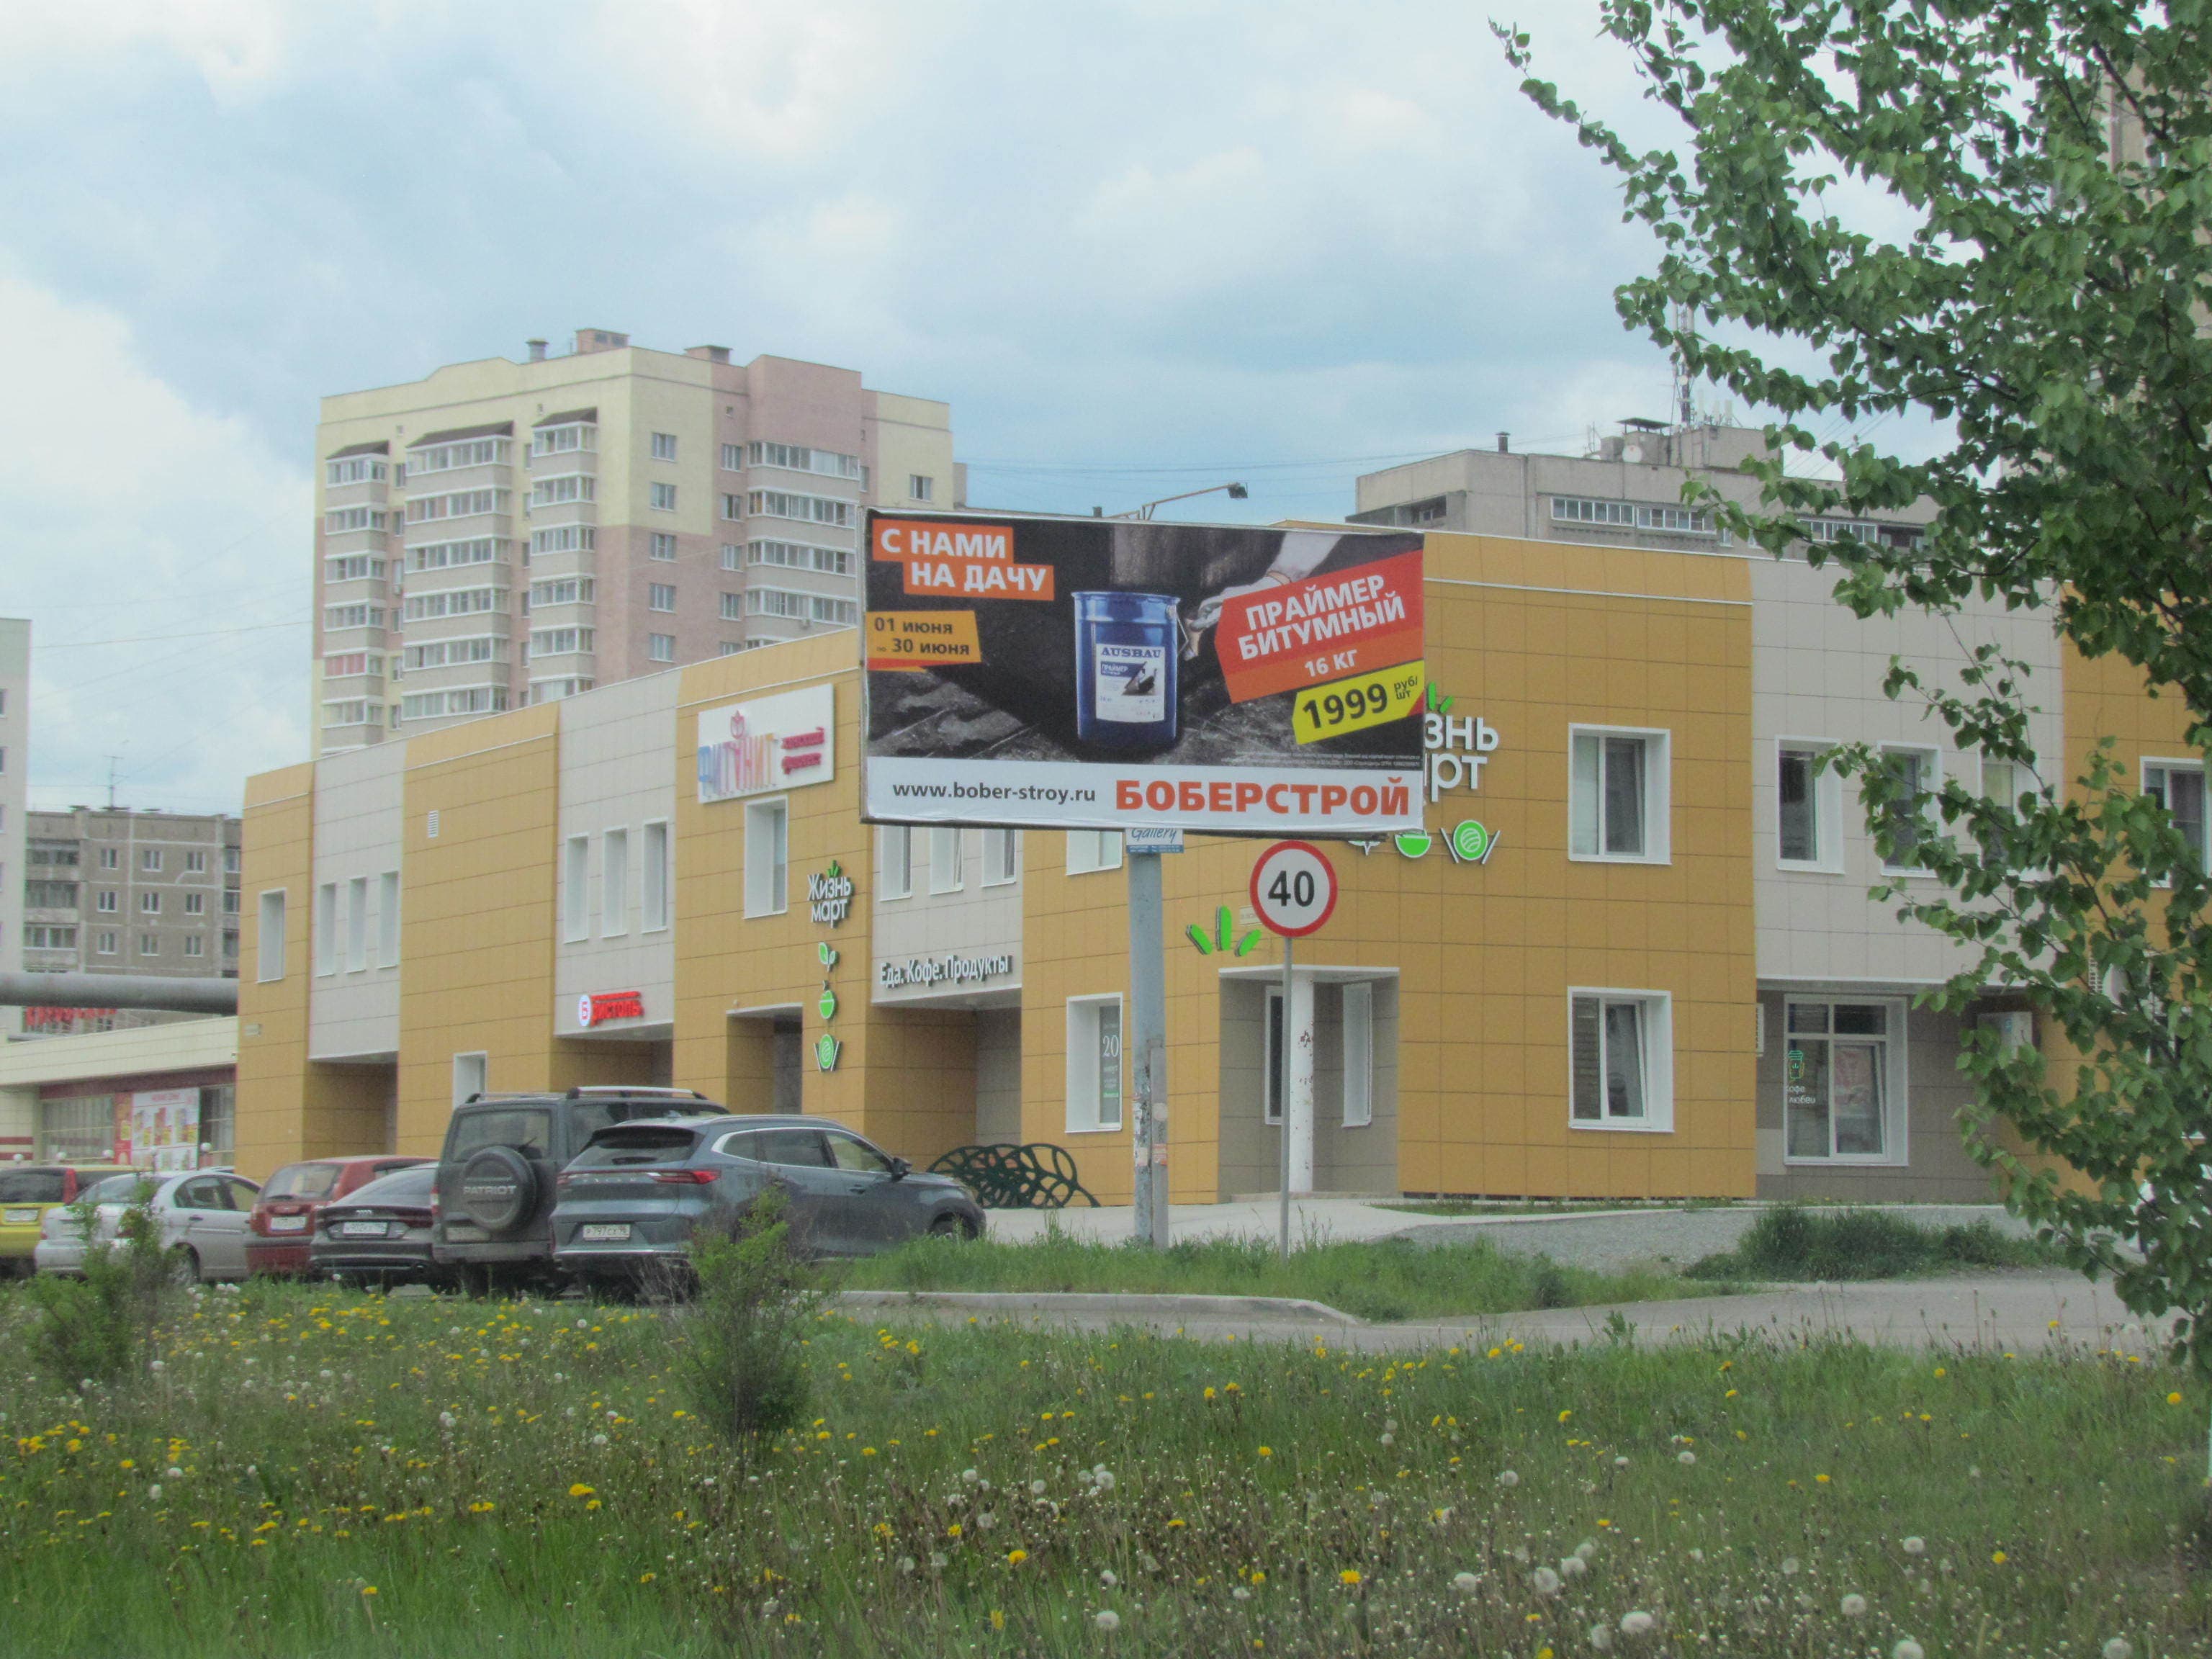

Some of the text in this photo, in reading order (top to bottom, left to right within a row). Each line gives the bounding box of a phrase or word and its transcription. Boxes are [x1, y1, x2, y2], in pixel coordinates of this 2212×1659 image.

[880, 528, 1006, 559] С НАМИ
[911, 562, 1047, 593] НА ДАЧУ
[1245, 575, 1385, 631] ПРАЙМЕР
[874, 617, 953, 634] 01 июня
[1238, 590, 1406, 660] БИТУМНЫЙ
[892, 638, 913, 653] 30
[920, 642, 970, 655] июня
[1101, 647, 1161, 658] AUSBAU
[1304, 649, 1358, 677] 16 КГ
[1302, 683, 1388, 729] 1999
[1425, 712, 1499, 751] знь
[892, 781, 1096, 805] www.bober-stroy.ru
[1115, 776, 1409, 816] БОБЕРСТРОЙ
[1131, 827, 1177, 844] Gallery
[806, 873, 852, 901] Жизнь
[1267, 870, 1315, 907] 40
[811, 899, 848, 929] март
[945, 953, 1010, 984] Продукты
[1102, 1035, 1119, 1058] 20
[463, 1185, 518, 1195] PATRIOT
